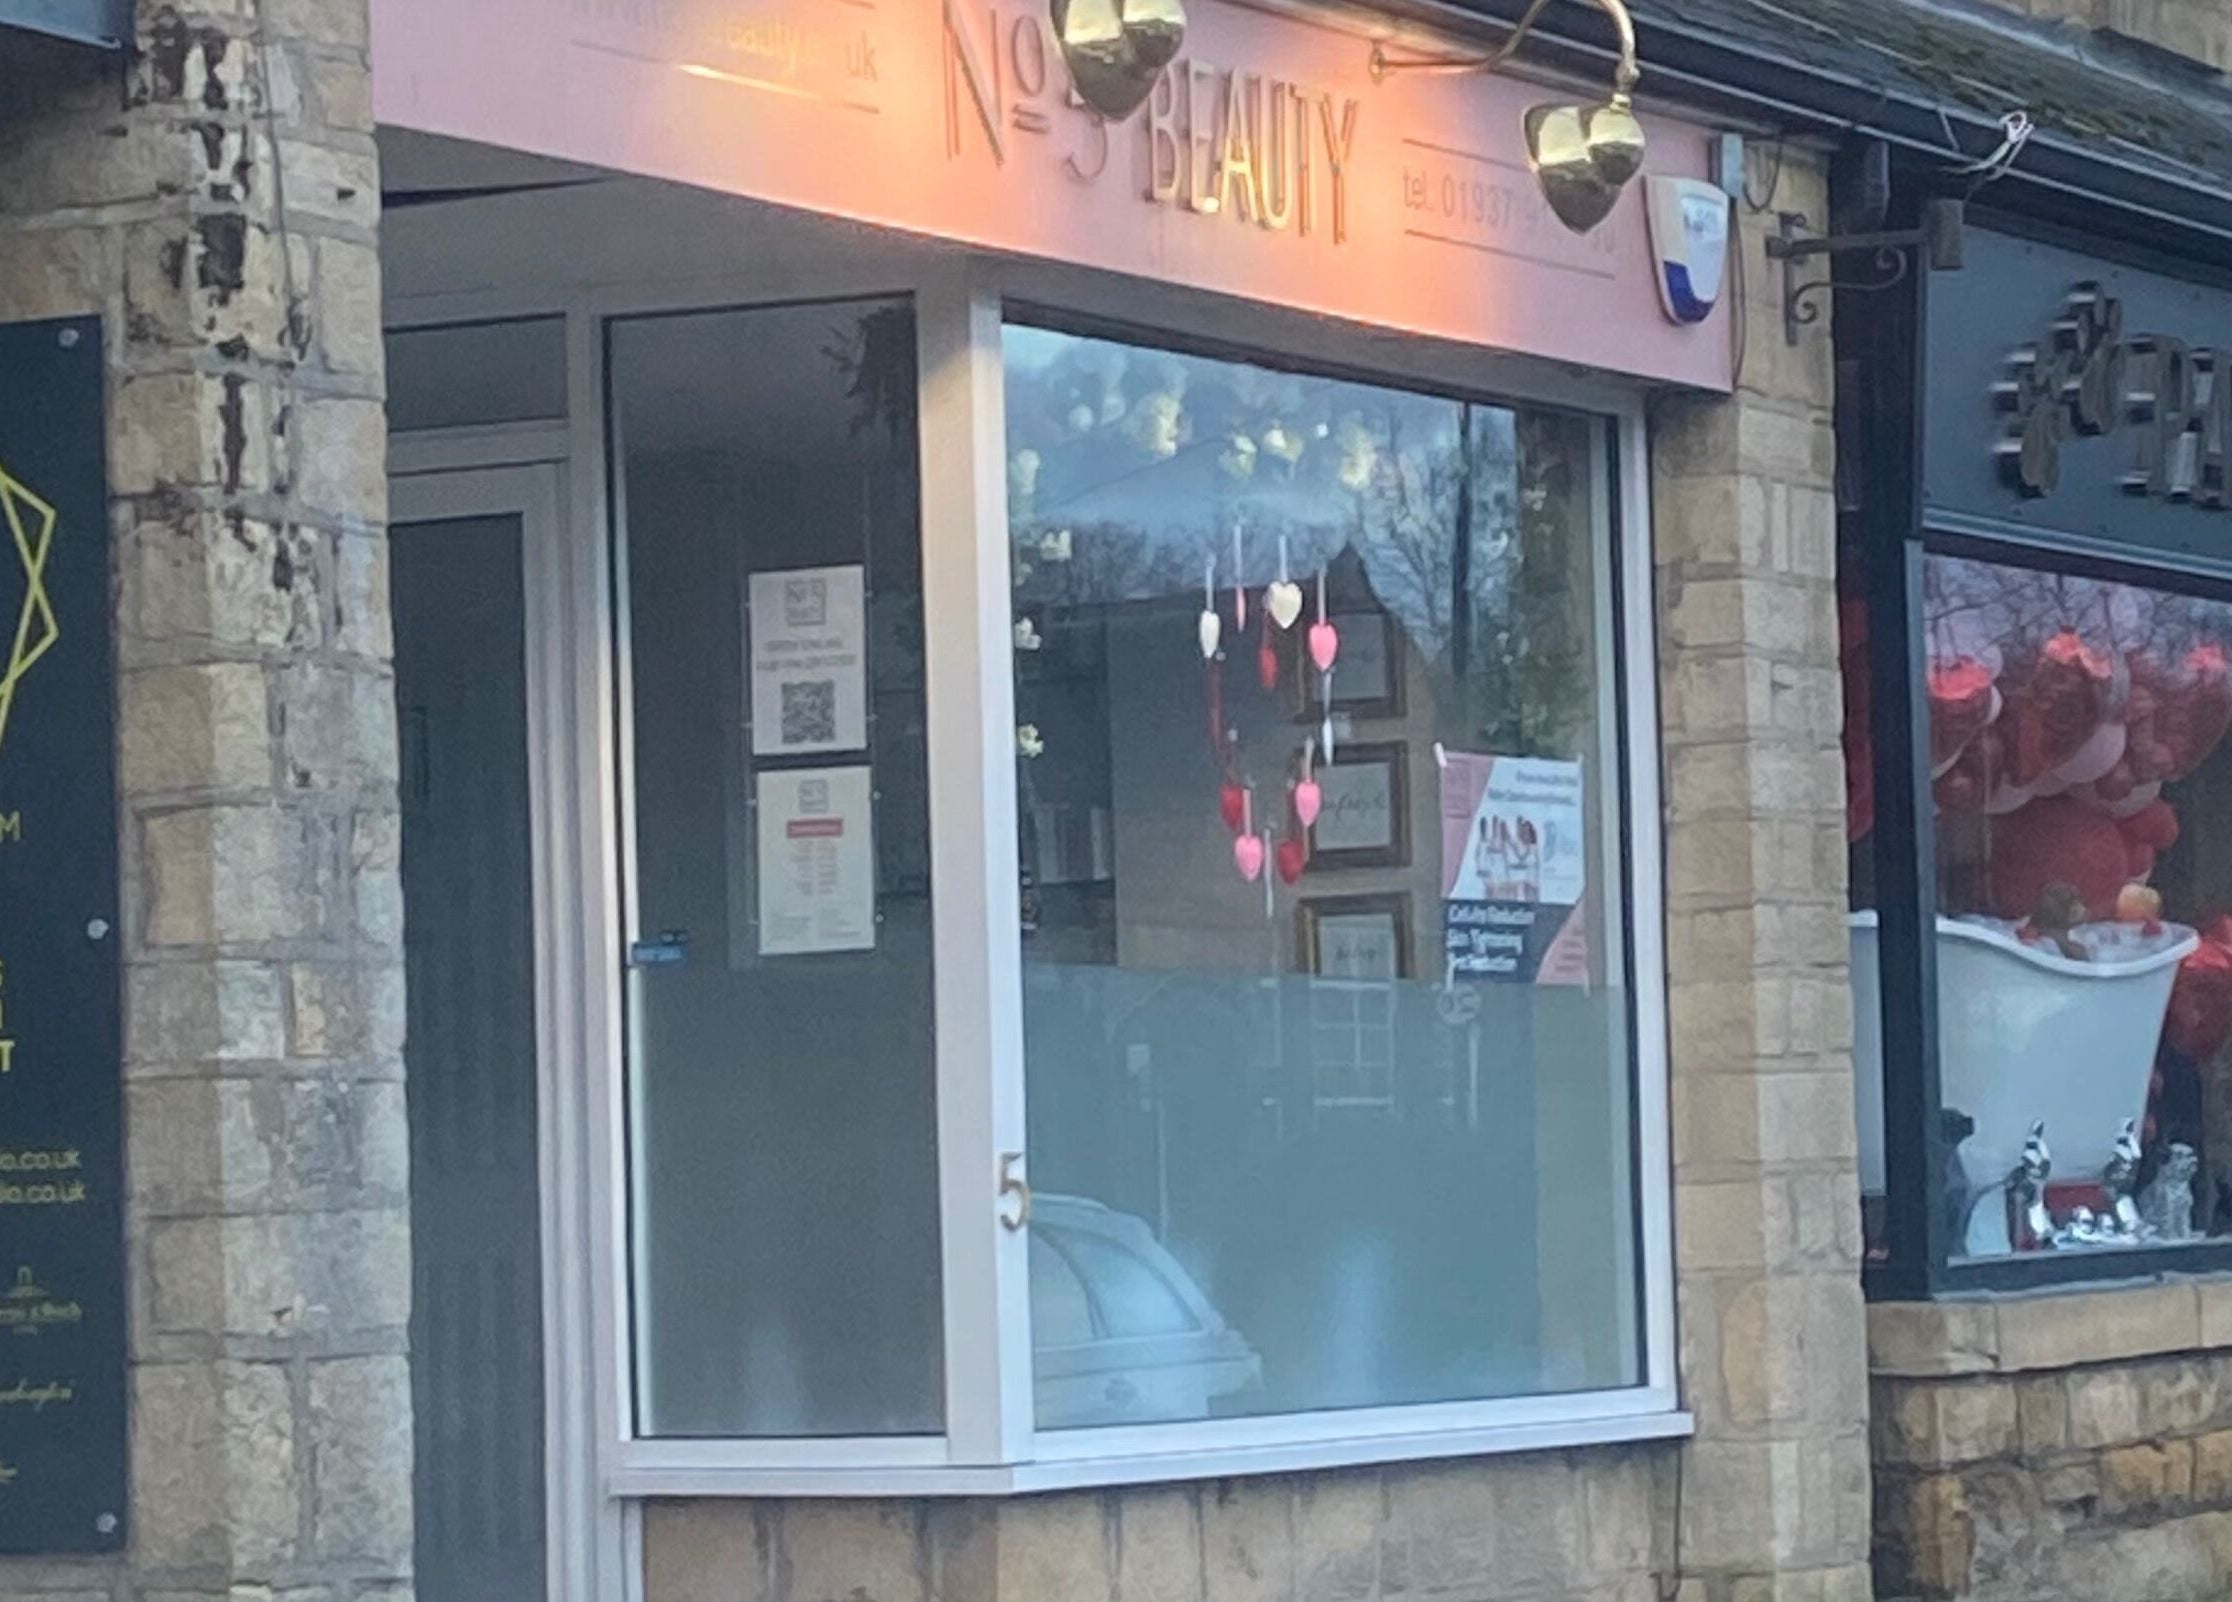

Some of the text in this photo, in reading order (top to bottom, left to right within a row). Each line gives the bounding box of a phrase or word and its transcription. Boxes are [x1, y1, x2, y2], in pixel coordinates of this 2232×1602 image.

[1145, 57, 1358, 245] BEAUTY
[1441, 172, 1514, 230] 01937
[999, 1151, 1030, 1231] 5
